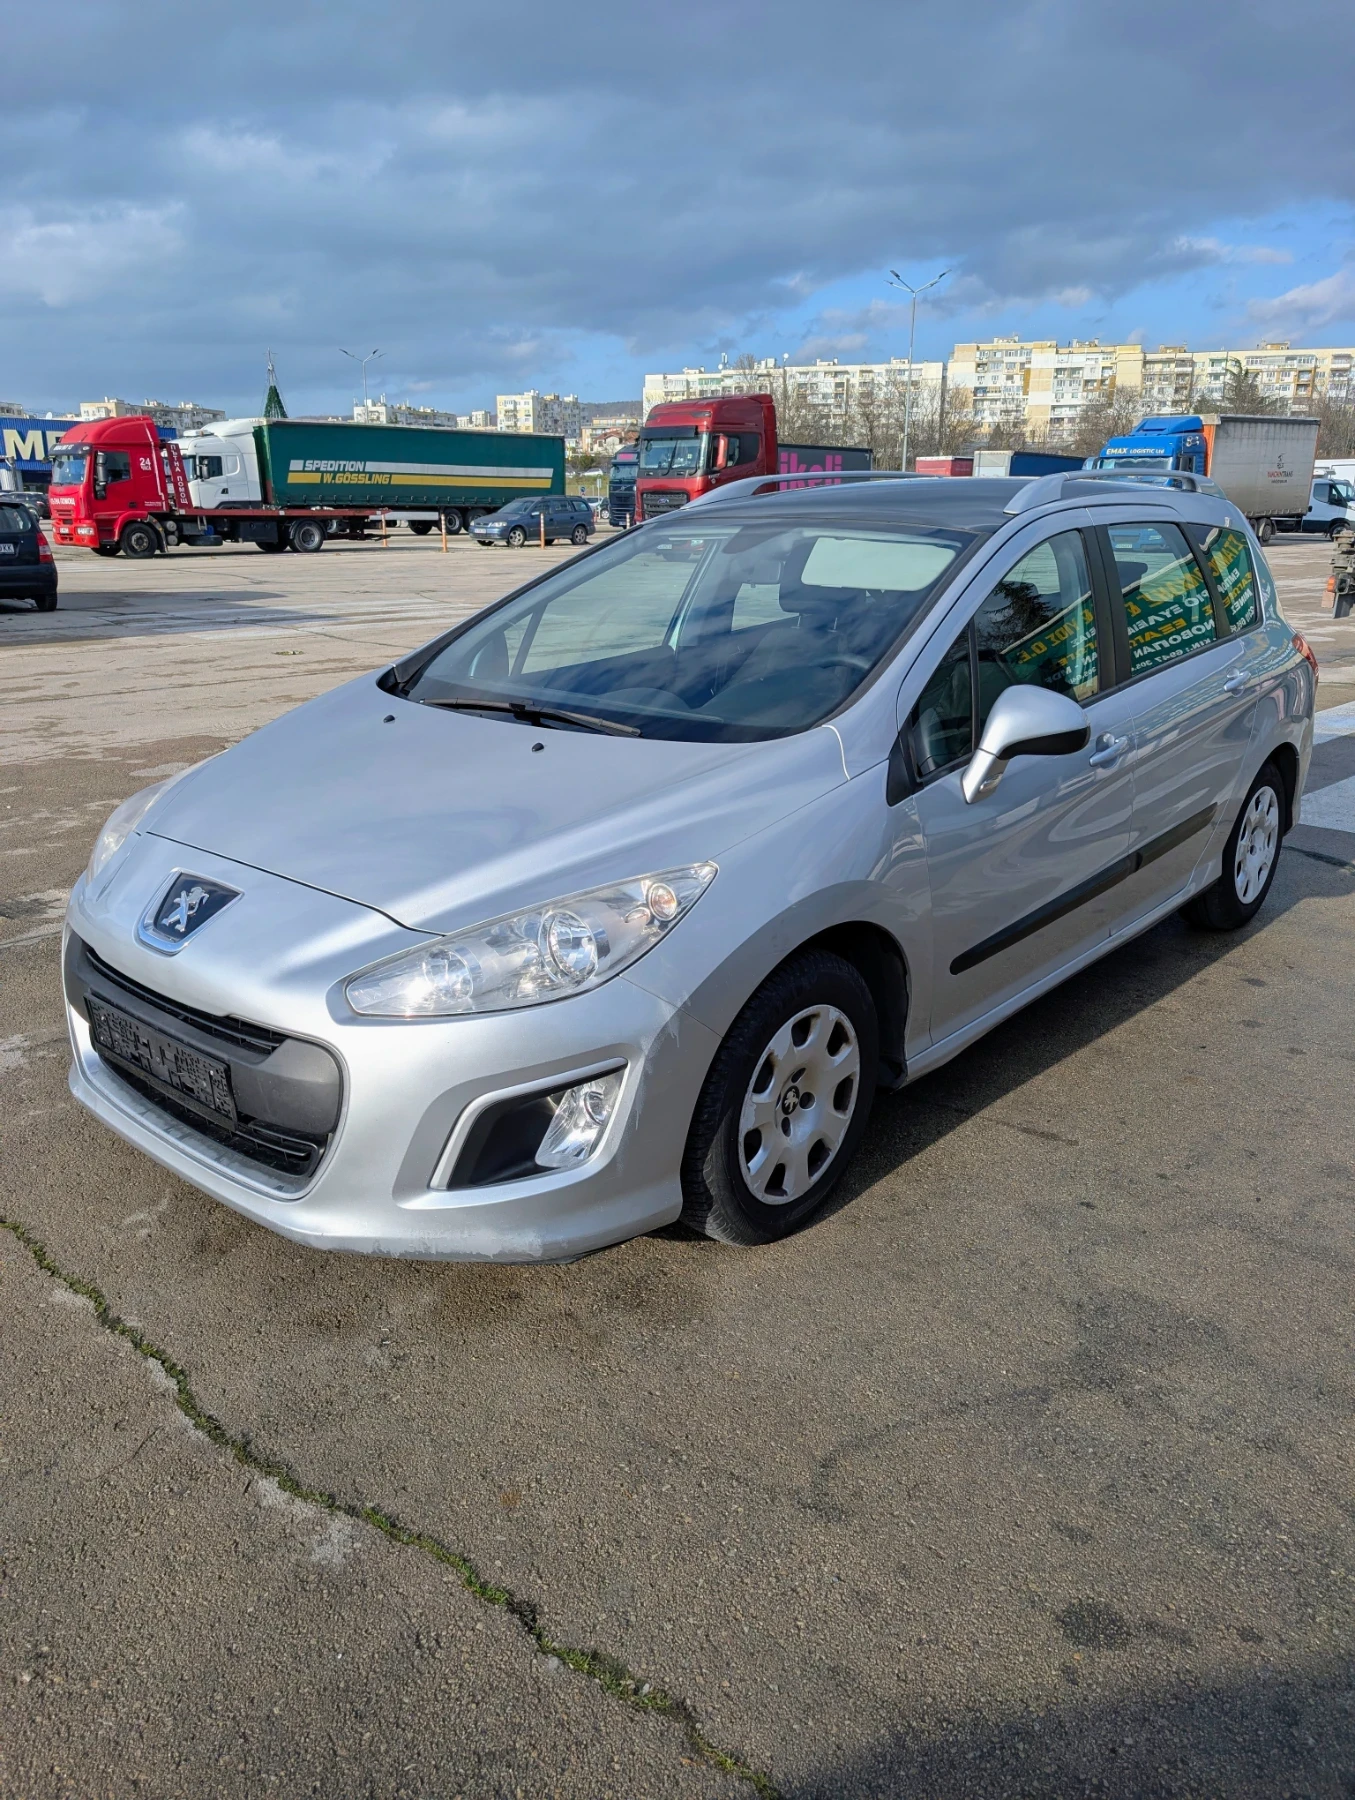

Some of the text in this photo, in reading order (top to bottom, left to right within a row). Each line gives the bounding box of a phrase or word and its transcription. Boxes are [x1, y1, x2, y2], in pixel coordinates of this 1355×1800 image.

[1106, 447, 1128, 455] EMAX
[139, 457, 151, 466] 24
[305, 460, 364, 472] SPEDITION
[170, 444, 189, 505] ПЪТНА ПОМОЩ
